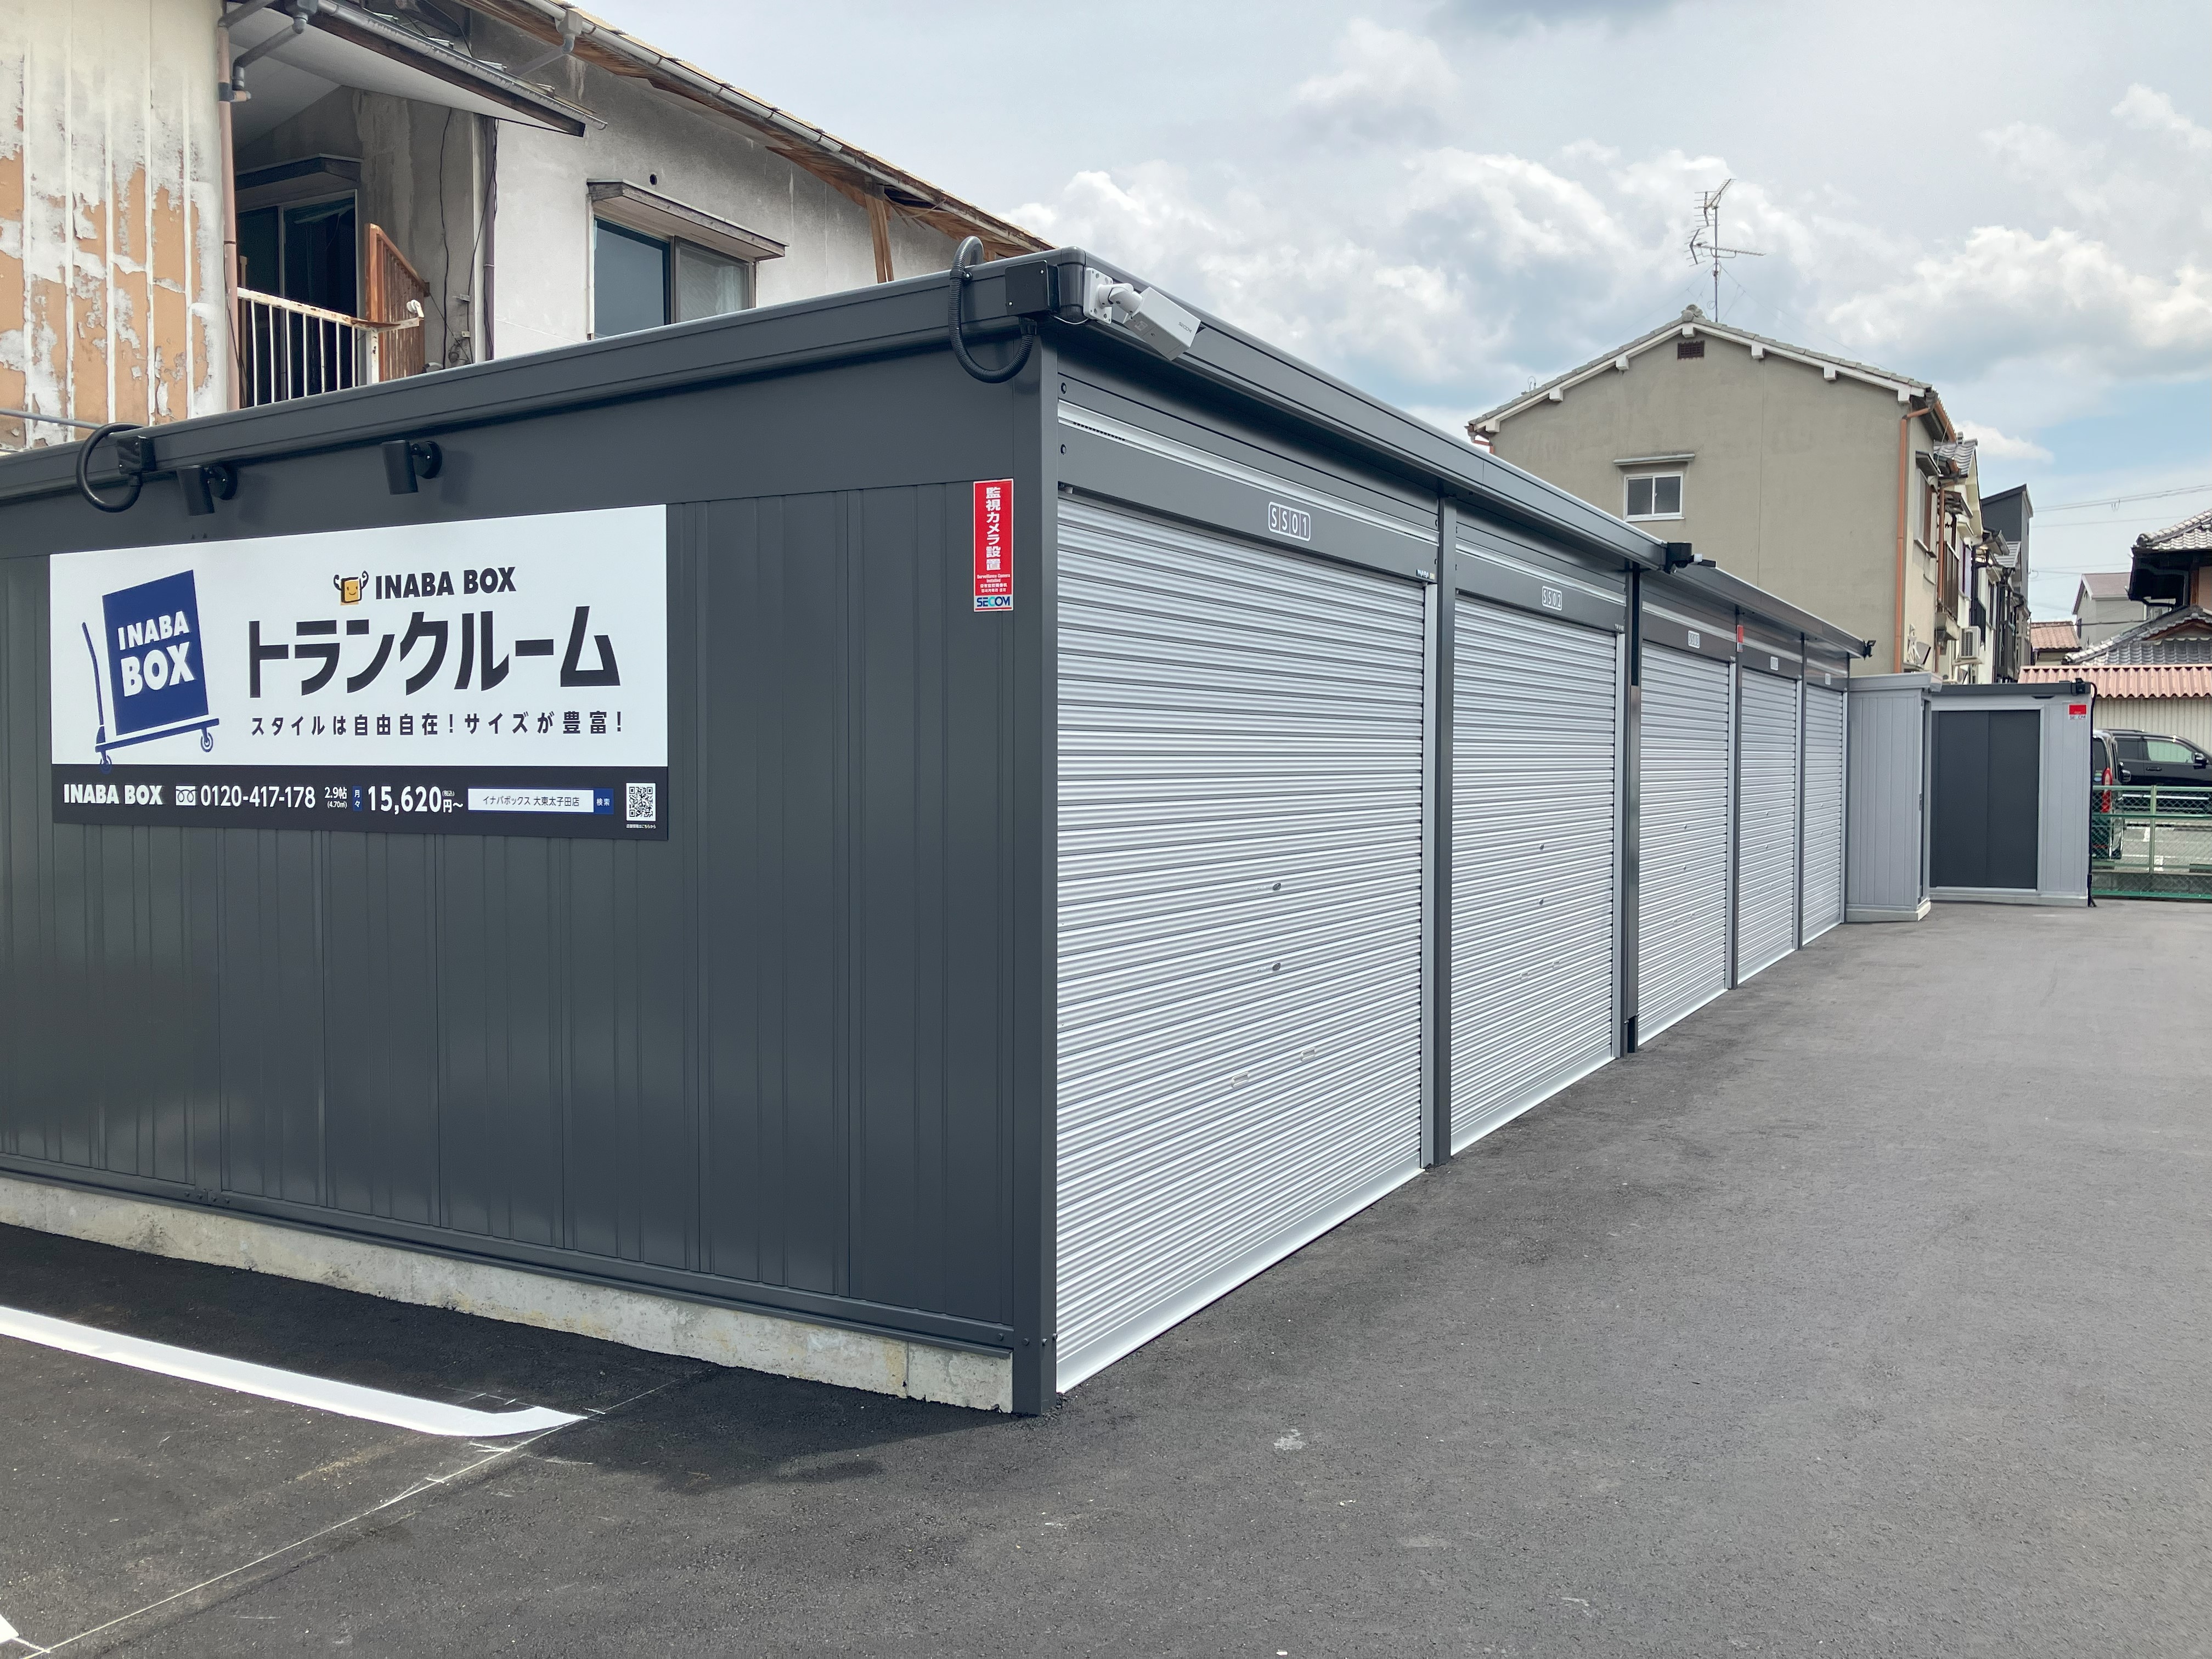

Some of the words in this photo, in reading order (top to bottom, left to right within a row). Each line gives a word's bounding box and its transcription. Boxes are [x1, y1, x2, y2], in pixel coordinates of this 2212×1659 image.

[985, 487, 1001, 571] 監視カメラ設置
[1271, 507, 1307, 536] SS01
[375, 571, 455, 600] INABA
[464, 566, 517, 595] BOX
[977, 596, 1011, 607] SECOM
[1543, 589, 1561, 608] SS02
[117, 610, 190, 651] INABA
[249, 606, 621, 699] トランクルーム
[120, 641, 195, 697] BOX
[64, 783, 120, 805] INABA
[124, 785, 163, 806] BOX
[201, 785, 316, 809] 0120-417-178
[324, 786, 347, 799] 2.9帖
[354, 789, 360, 808] 月々
[483, 795, 531, 806] イナバボックス
[533, 796, 580, 807] 大東太子田店
[596, 798, 611, 806] 検索
